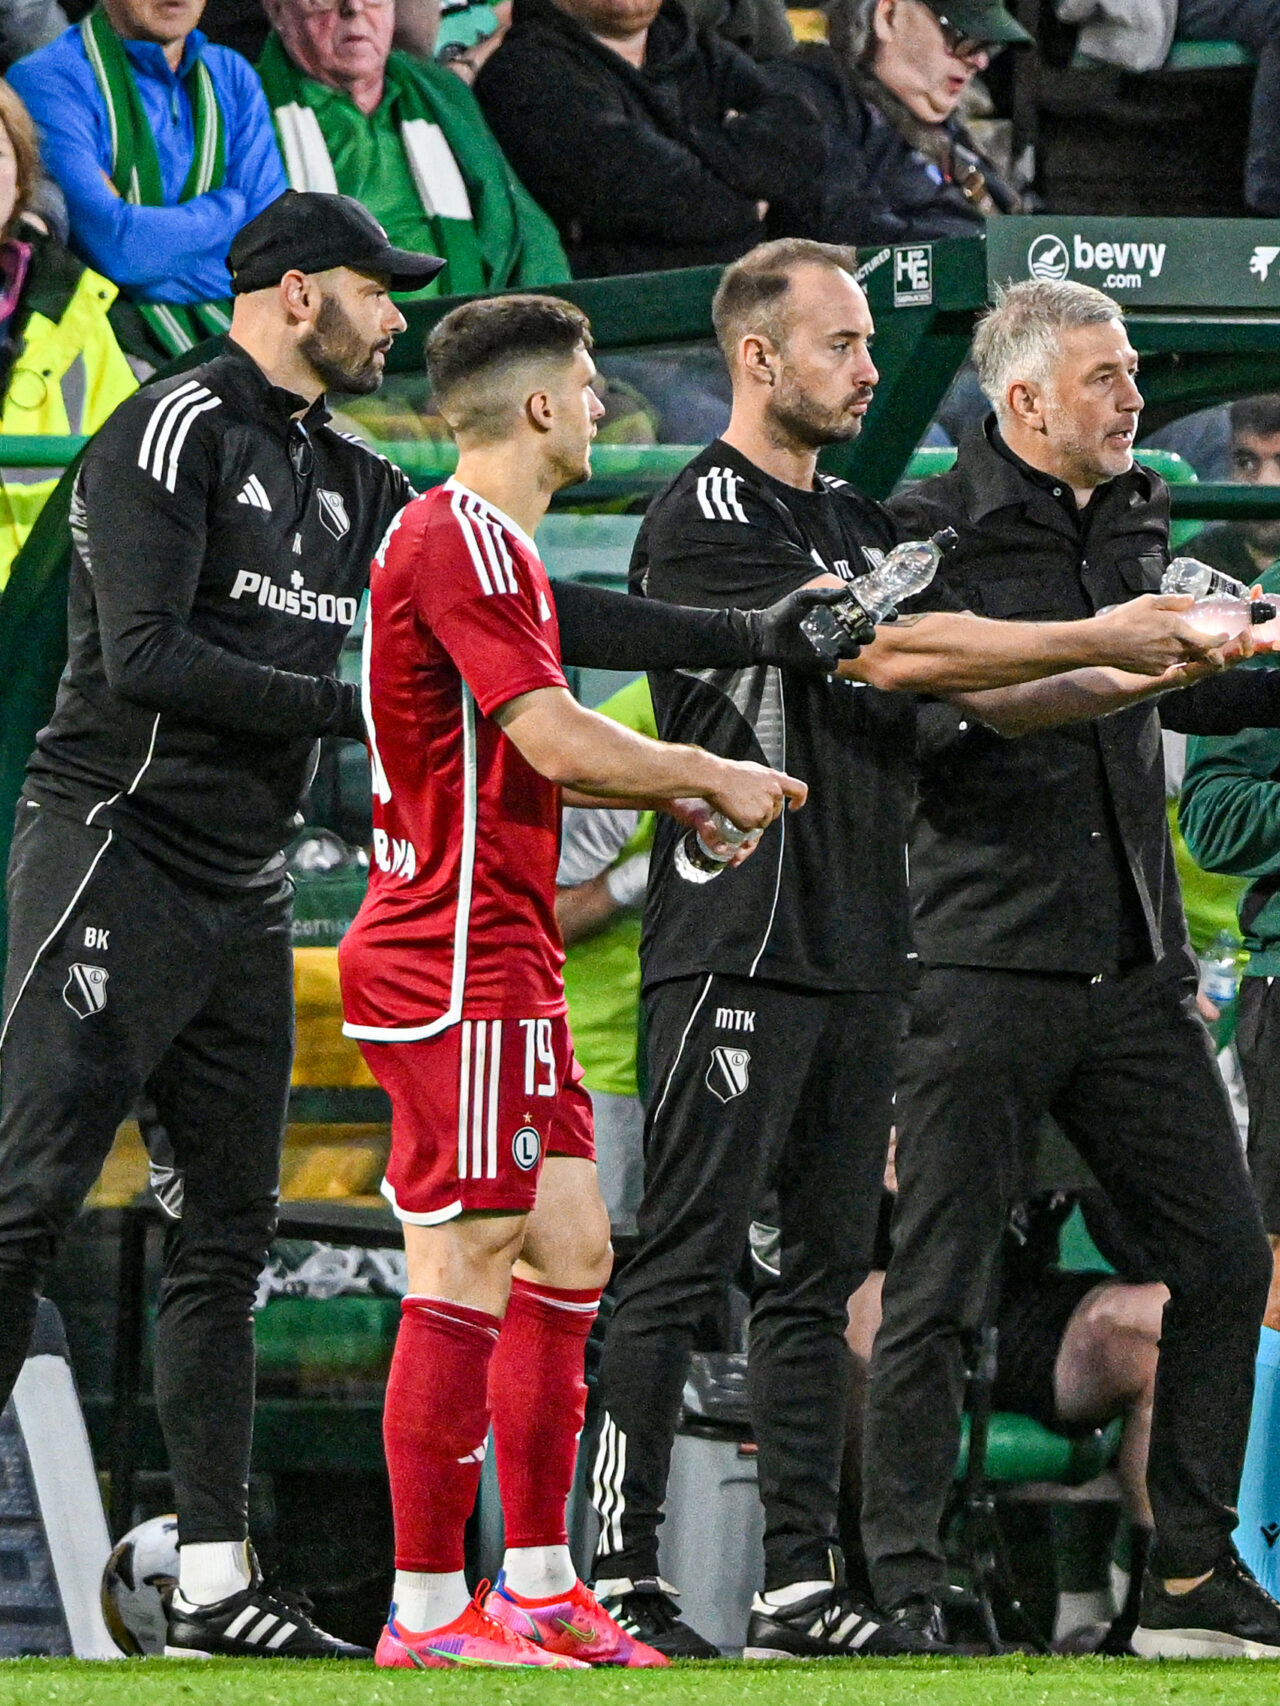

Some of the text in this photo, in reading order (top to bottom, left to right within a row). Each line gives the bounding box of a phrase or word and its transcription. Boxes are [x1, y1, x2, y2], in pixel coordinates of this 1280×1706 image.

[1073, 234, 1166, 278] bevvy
[1102, 272, 1142, 289] .com
[229, 569, 358, 626] Plus500
[84, 926, 111, 951] BK
[714, 1007, 756, 1033] MTK
[518, 1018, 556, 1097] 19
